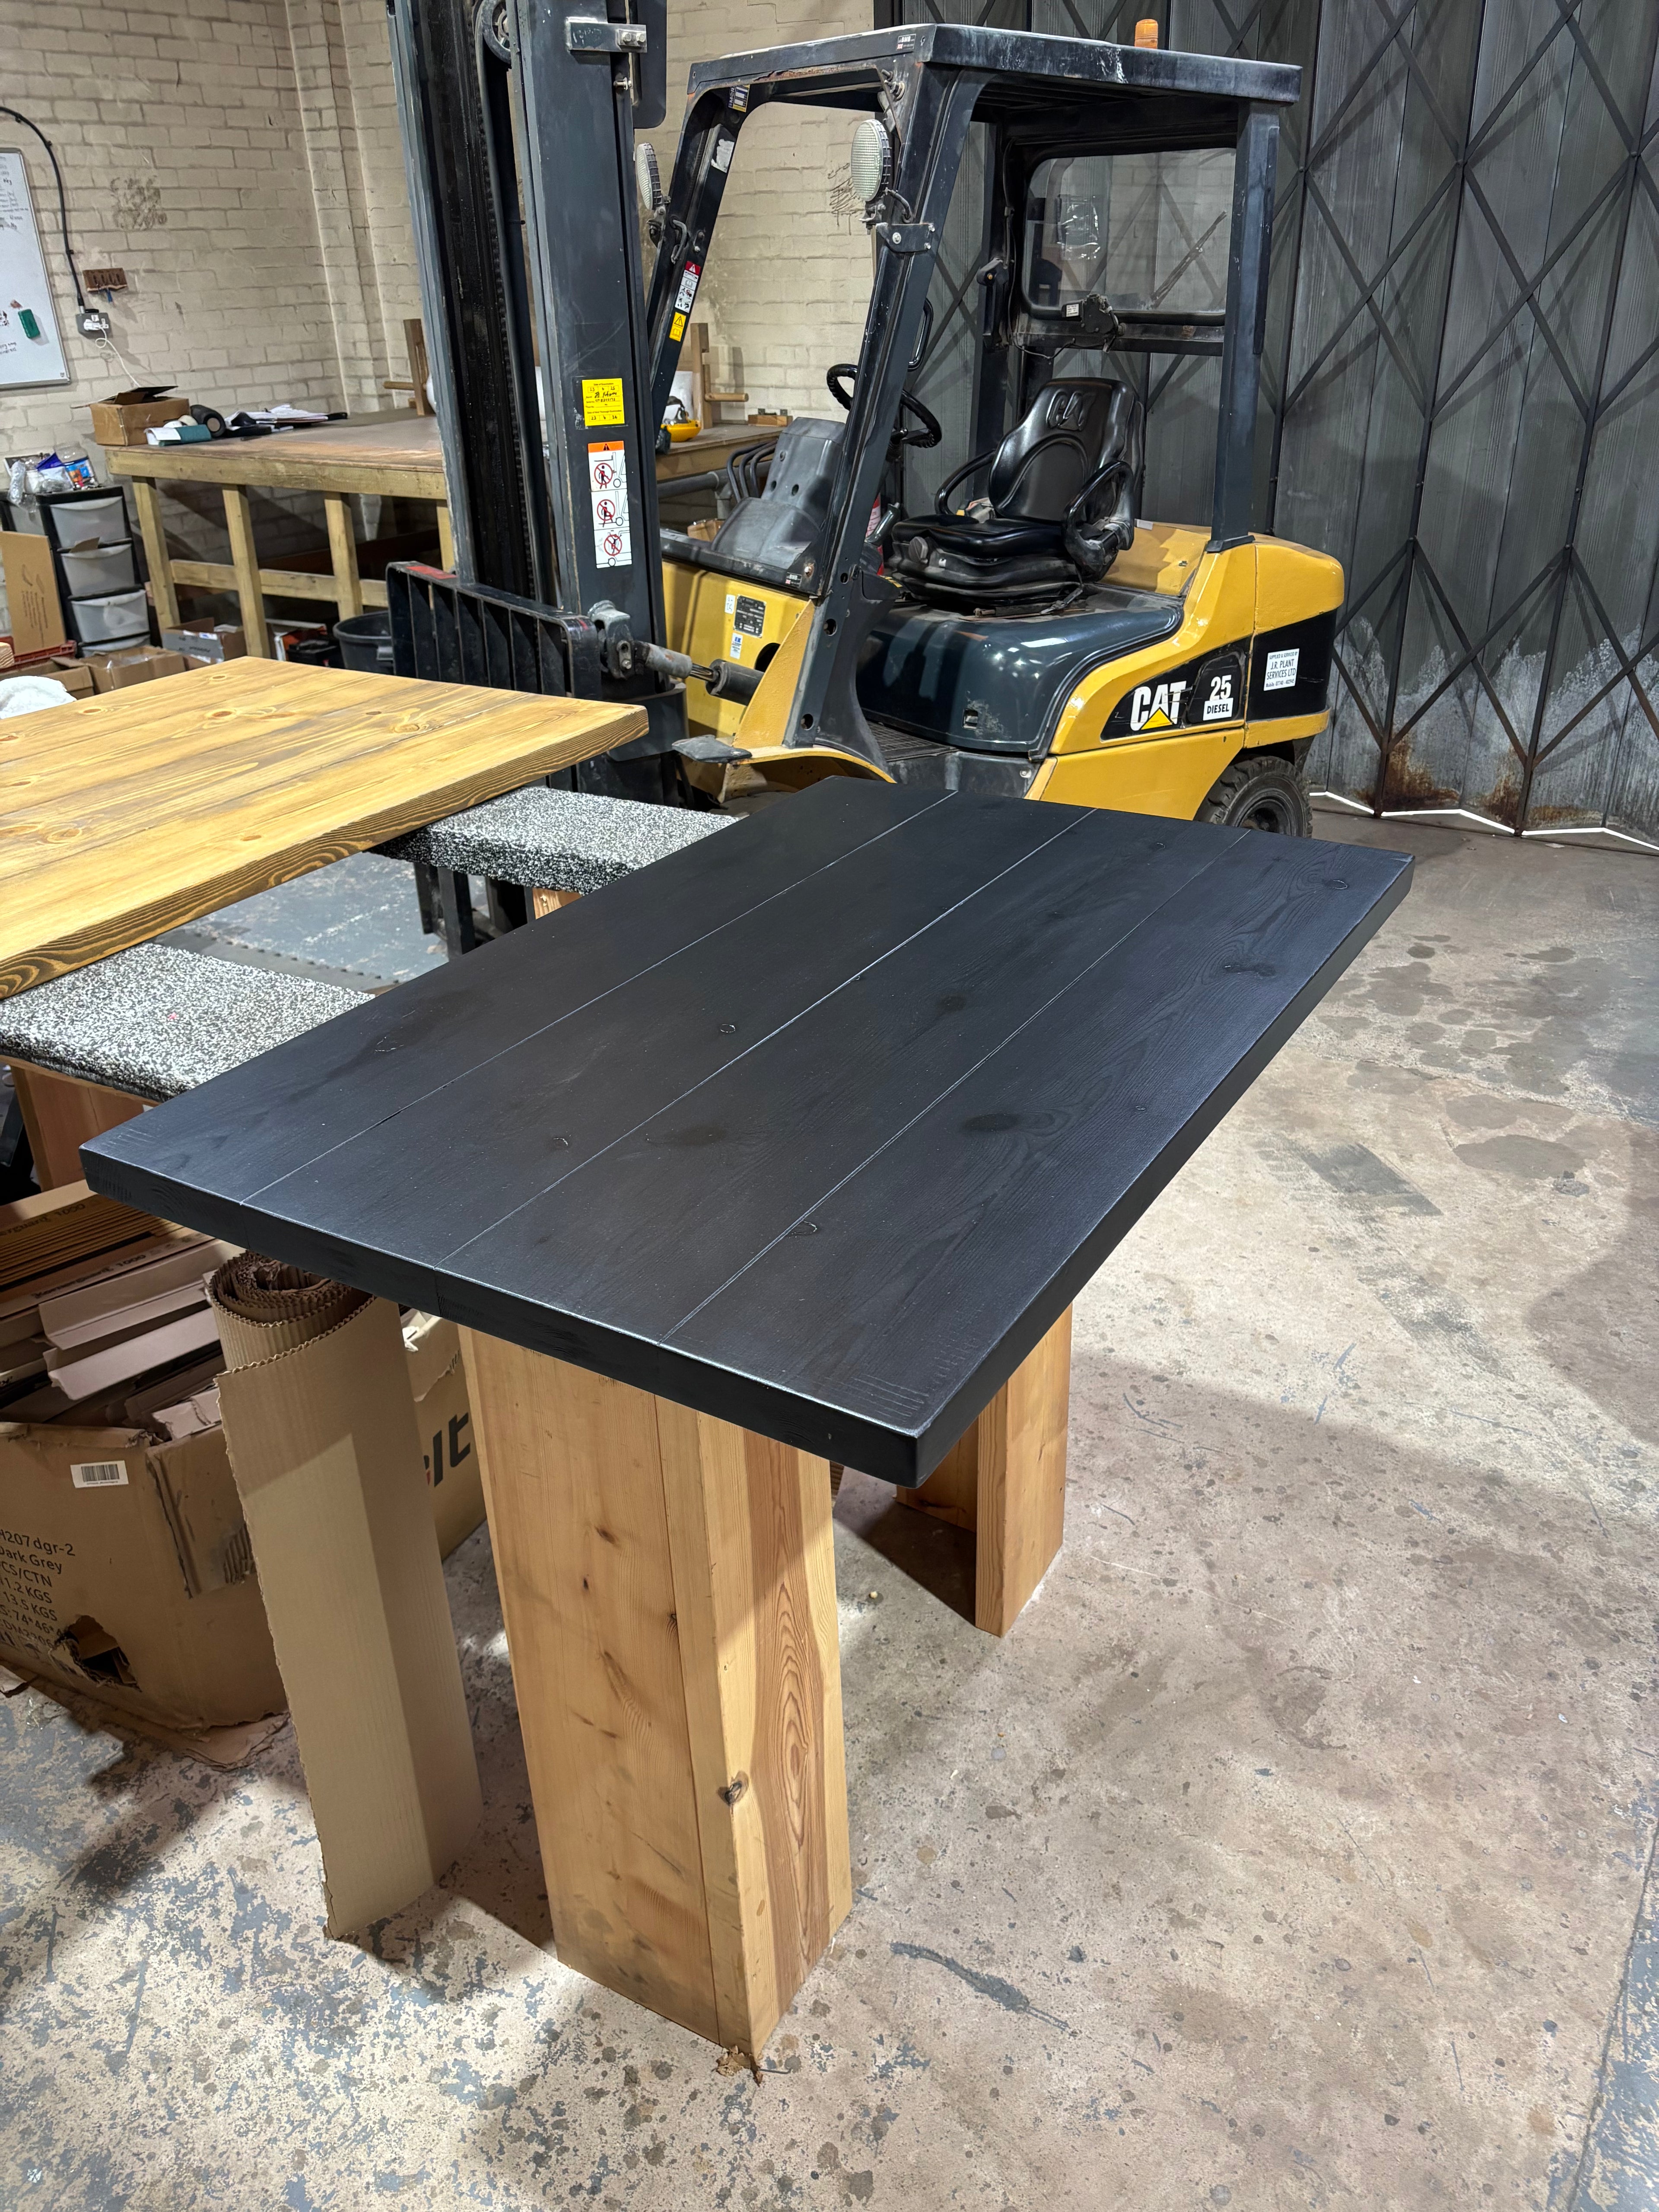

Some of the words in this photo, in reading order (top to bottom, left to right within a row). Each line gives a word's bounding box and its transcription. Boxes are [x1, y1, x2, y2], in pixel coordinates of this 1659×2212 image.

[1046, 388, 1096, 431] CAT
[1280, 659, 1295, 668] PLANT
[1267, 669, 1287, 680] SERVICES
[1288, 668, 1296, 677] LTD
[1210, 675, 1231, 701] 25
[1130, 681, 1186, 731] CAT
[1207, 704, 1230, 715] DIESEL
[0, 1560, 52, 1587] CS/CTN
[29, 1554, 62, 1574] Grey
[25, 1586, 52, 1604] KGS
[31, 1603, 57, 1621] KGS
